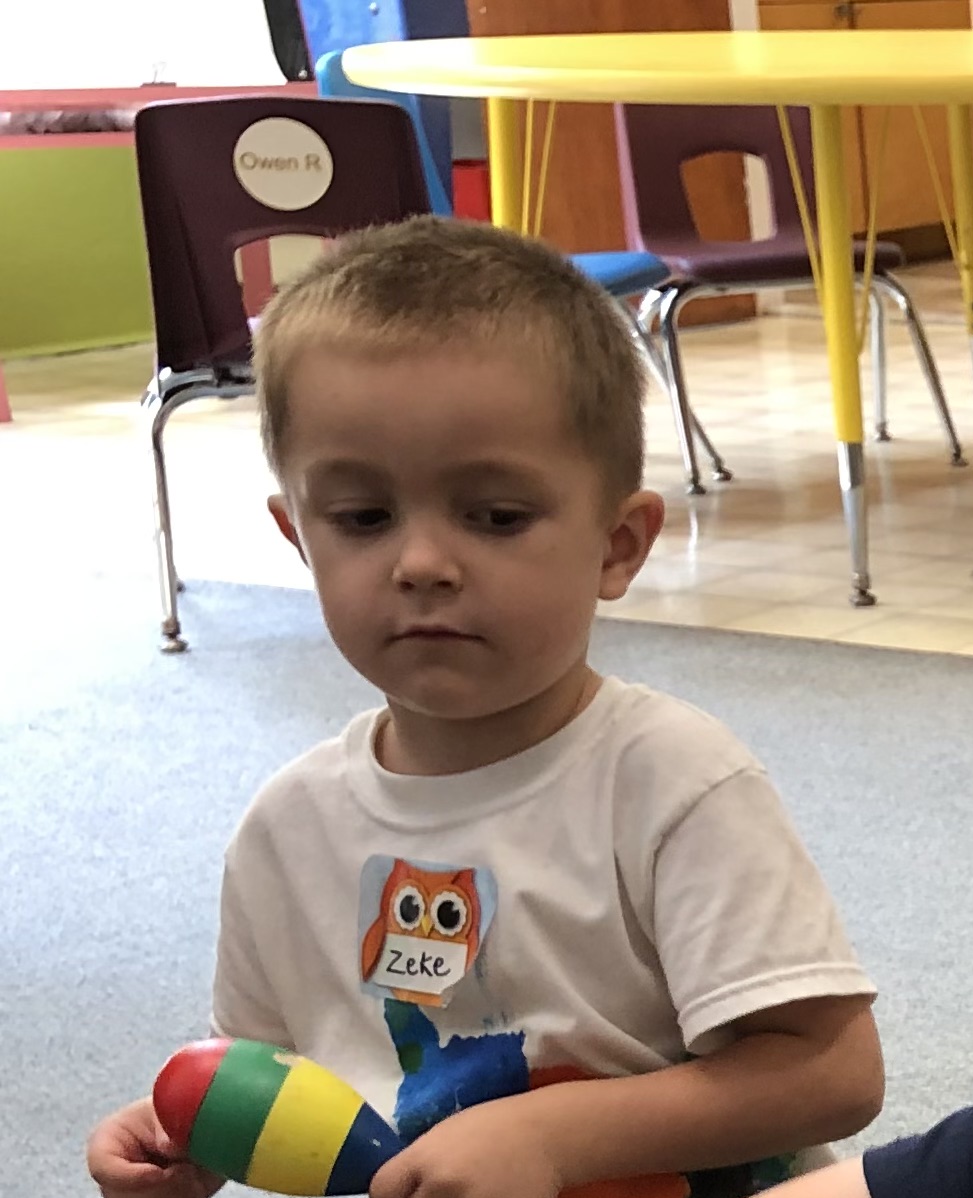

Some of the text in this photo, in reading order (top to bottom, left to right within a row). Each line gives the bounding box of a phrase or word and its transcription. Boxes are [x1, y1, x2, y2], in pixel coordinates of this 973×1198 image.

[240, 151, 322, 172] Owen R
[385, 949, 451, 977] Zeke
